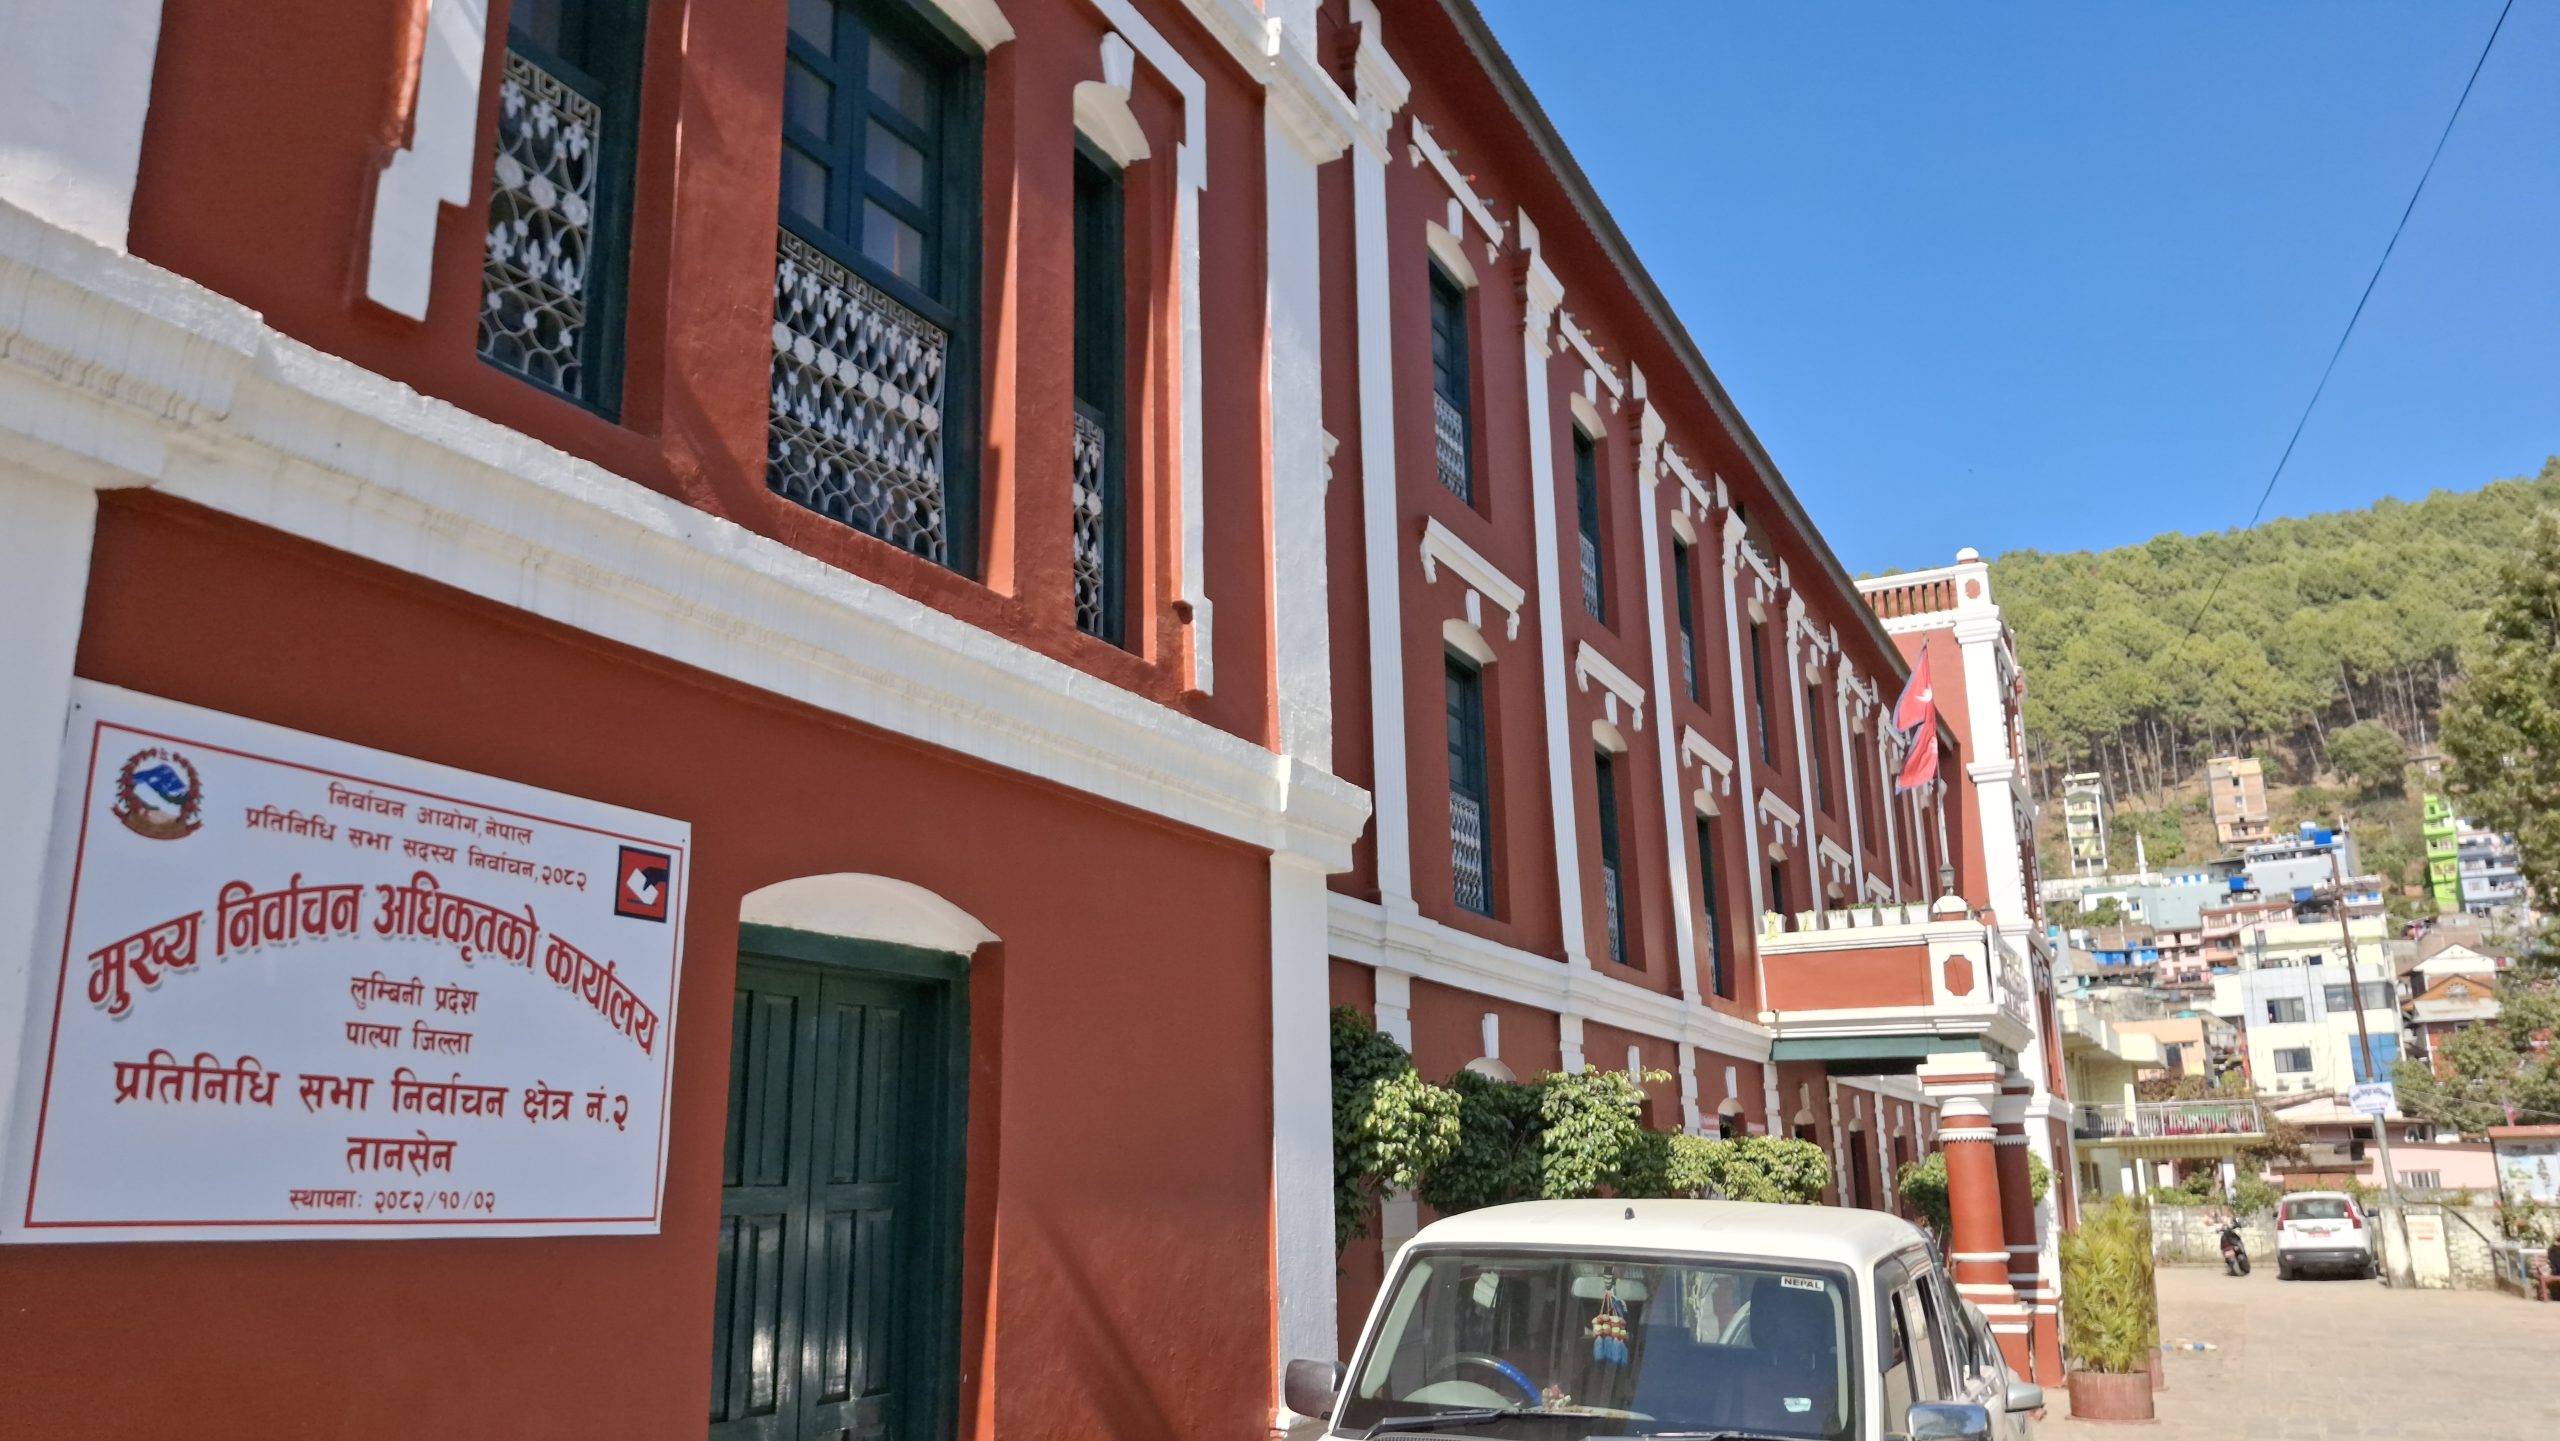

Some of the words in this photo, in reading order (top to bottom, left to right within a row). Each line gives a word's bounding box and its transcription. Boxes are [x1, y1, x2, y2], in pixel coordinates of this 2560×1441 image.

[328, 781, 407, 819] निर्वाचन
[246, 804, 338, 842] प्रतिनिधि
[348, 827, 393, 851] सभा
[403, 837, 459, 865] सदस्य
[88, 910, 204, 1016] मुख्य
[216, 872, 364, 957] निर्वाचन
[373, 869, 540, 969] अधिकृतको
[545, 932, 659, 1056] कार्यालय
[434, 981, 480, 1015] प्रदेश
[346, 1021, 402, 1050] पाल्पा
[412, 1018, 473, 1056] जिल्ला
[114, 1048, 281, 1106] प्रतिनिधि
[299, 1072, 375, 1113] सभा
[391, 1066, 510, 1118] निर्वाचन
[523, 1079, 575, 1124] क्षेत्र
[346, 1129, 458, 1177] तानसेन
[1784, 1278, 1821, 1289] NEPAL
